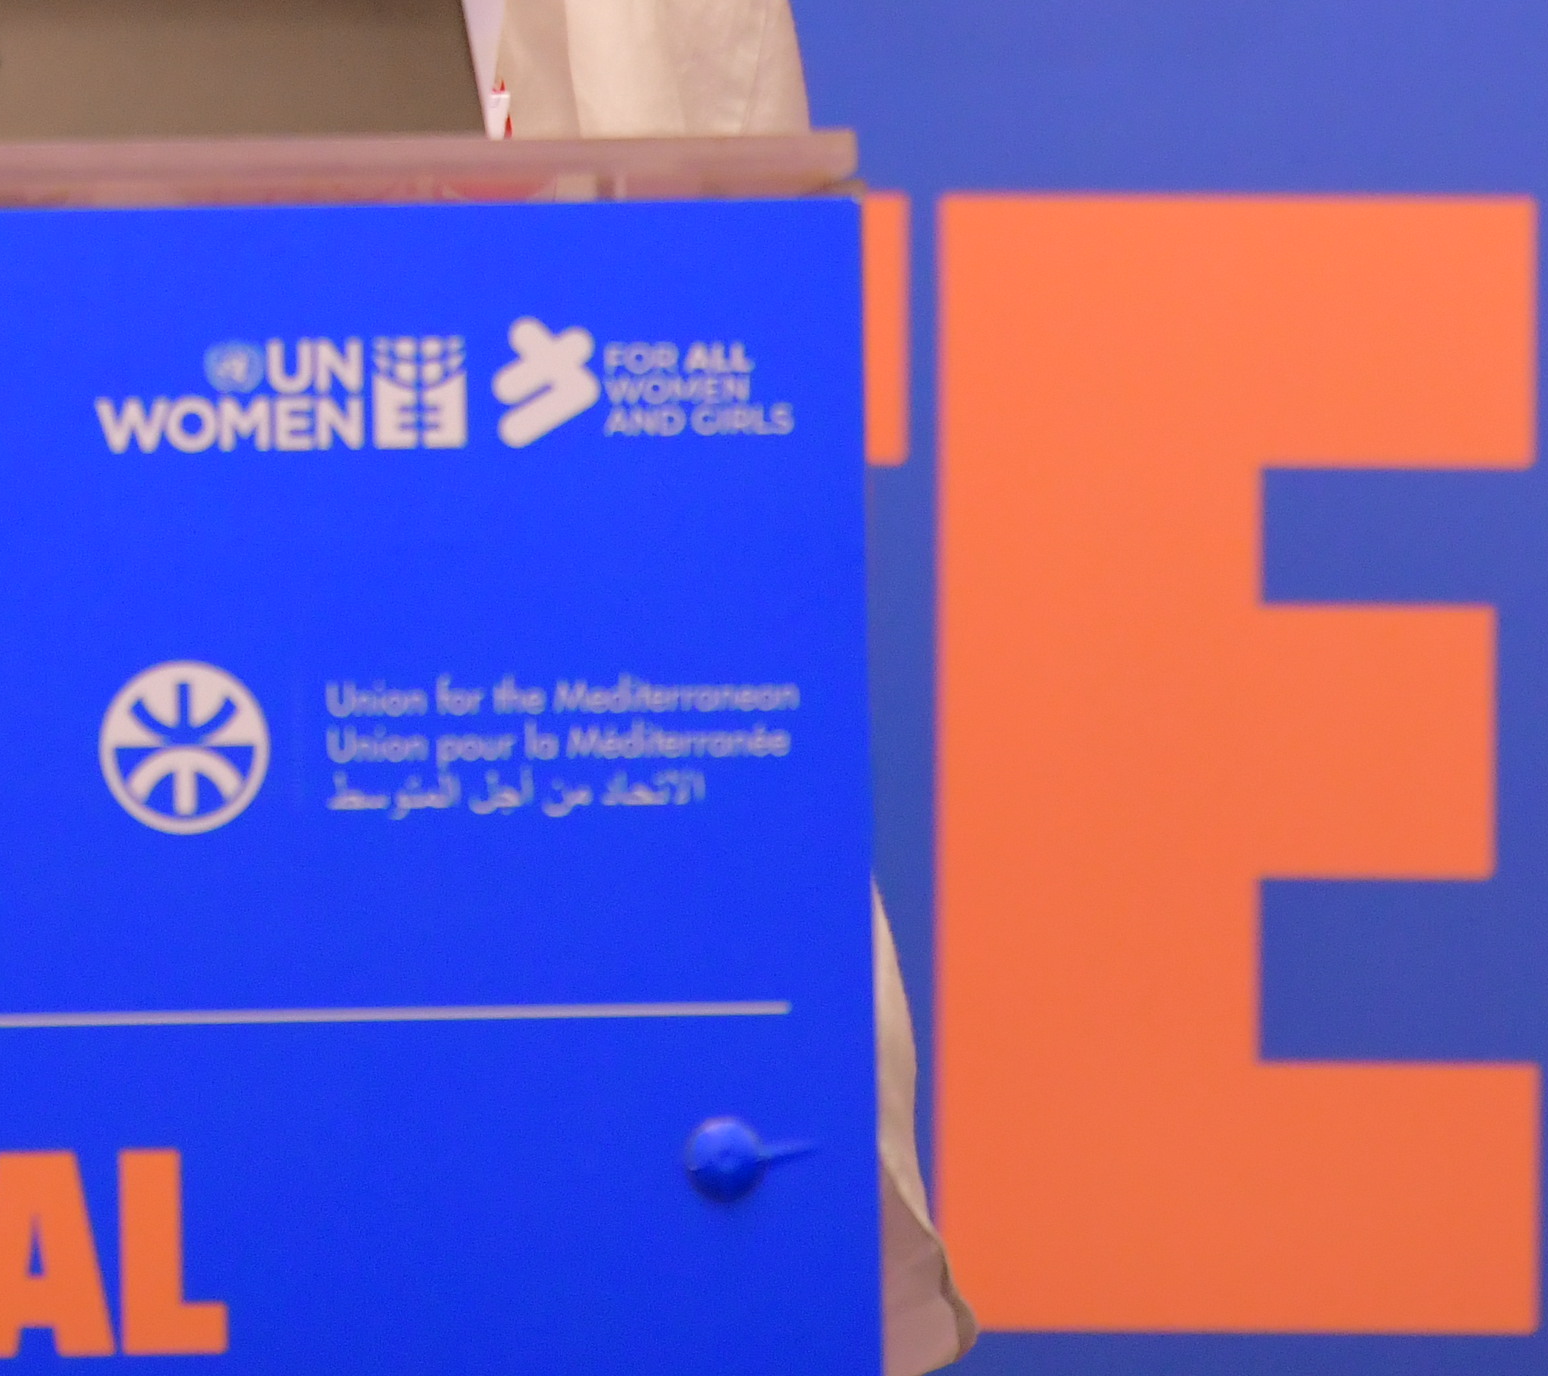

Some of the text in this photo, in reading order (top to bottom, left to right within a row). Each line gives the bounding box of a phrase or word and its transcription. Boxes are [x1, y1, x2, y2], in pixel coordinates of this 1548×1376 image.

[265, 335, 364, 394] UN
[604, 340, 755, 375] FOR ALL
[604, 372, 750, 405] WOMEN
[94, 394, 365, 454] WOMEN
[604, 402, 795, 437] AND GIRLS
[326, 672, 801, 718] Union for the Mediterranean
[326, 725, 430, 764] Union
[436, 734, 517, 773] pour
[524, 718, 559, 761] la
